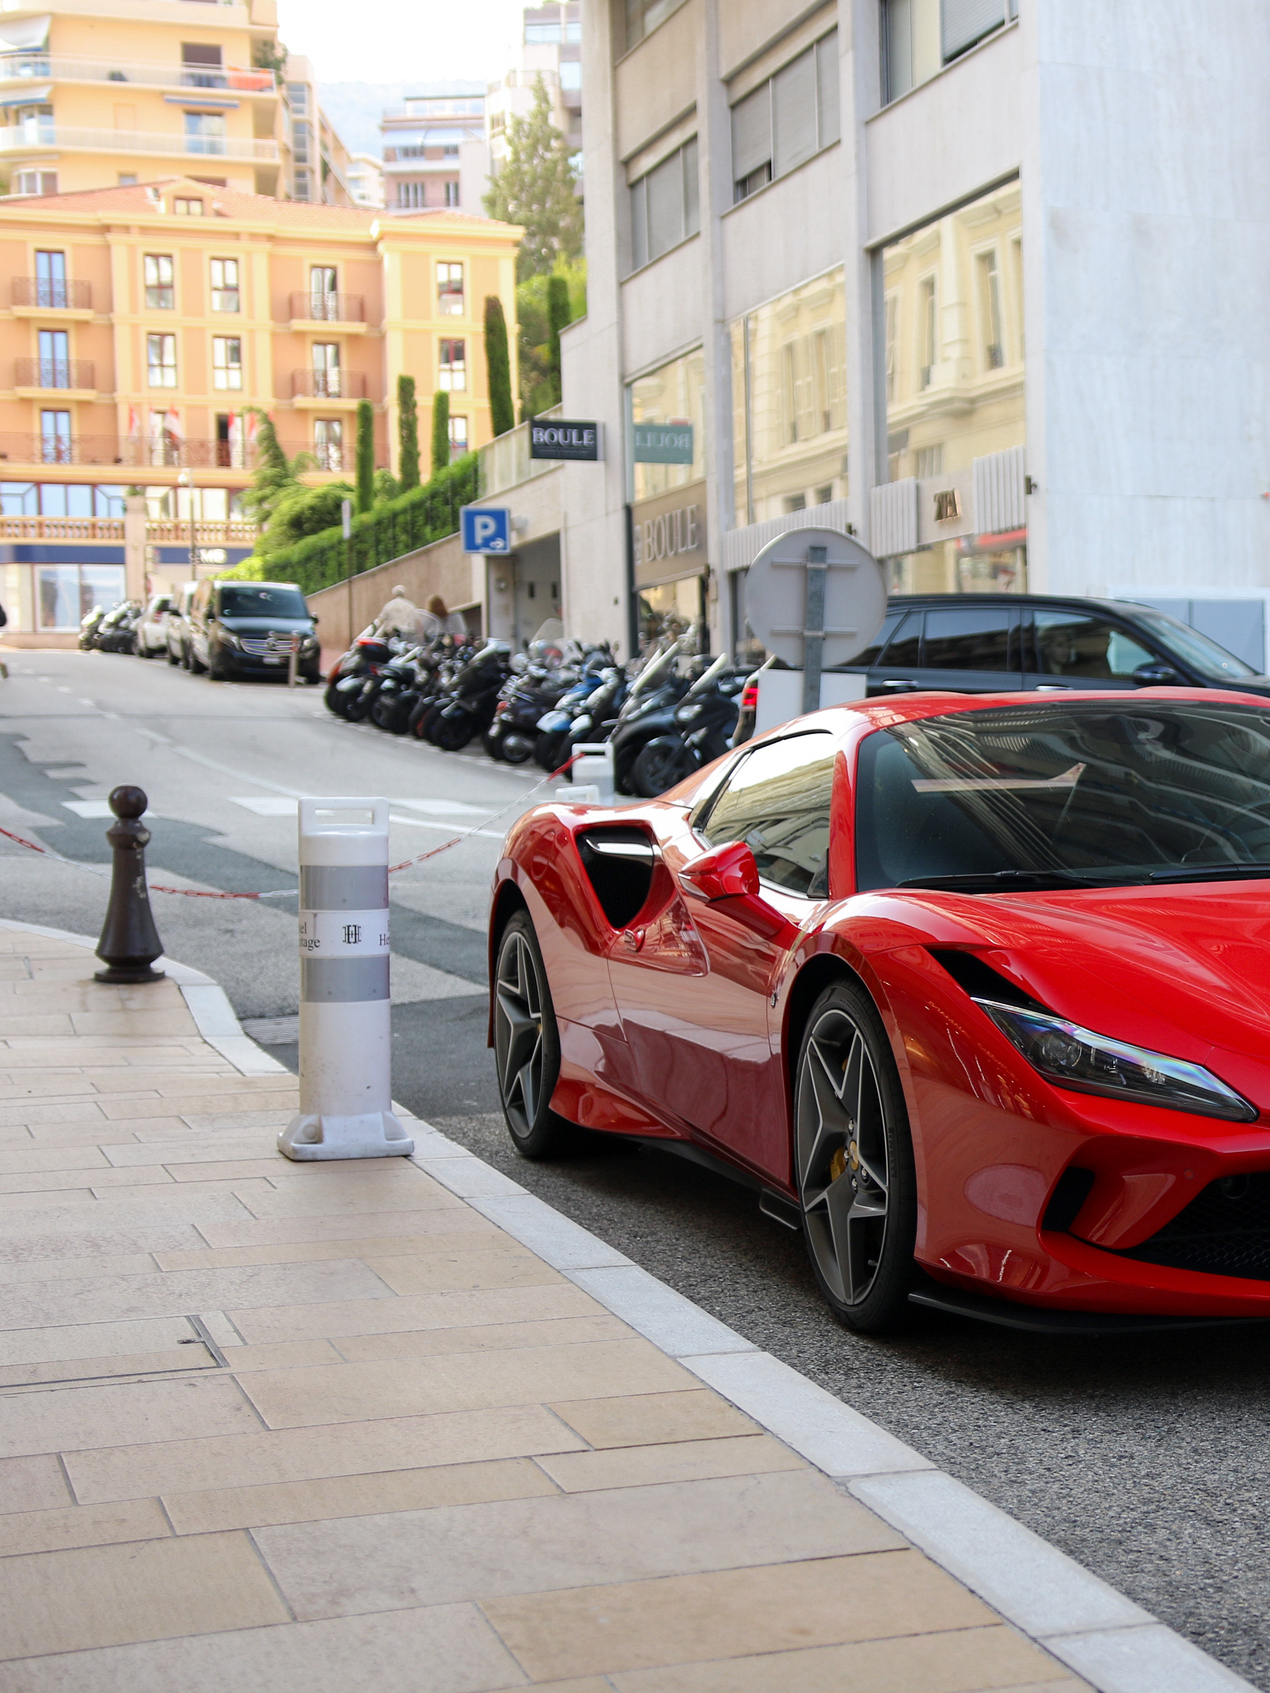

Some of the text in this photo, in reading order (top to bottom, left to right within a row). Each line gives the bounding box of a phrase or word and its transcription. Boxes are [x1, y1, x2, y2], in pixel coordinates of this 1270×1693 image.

[532, 427, 595, 447] BOULE
[474, 515, 497, 546] P
[644, 504, 699, 562] BOULE
